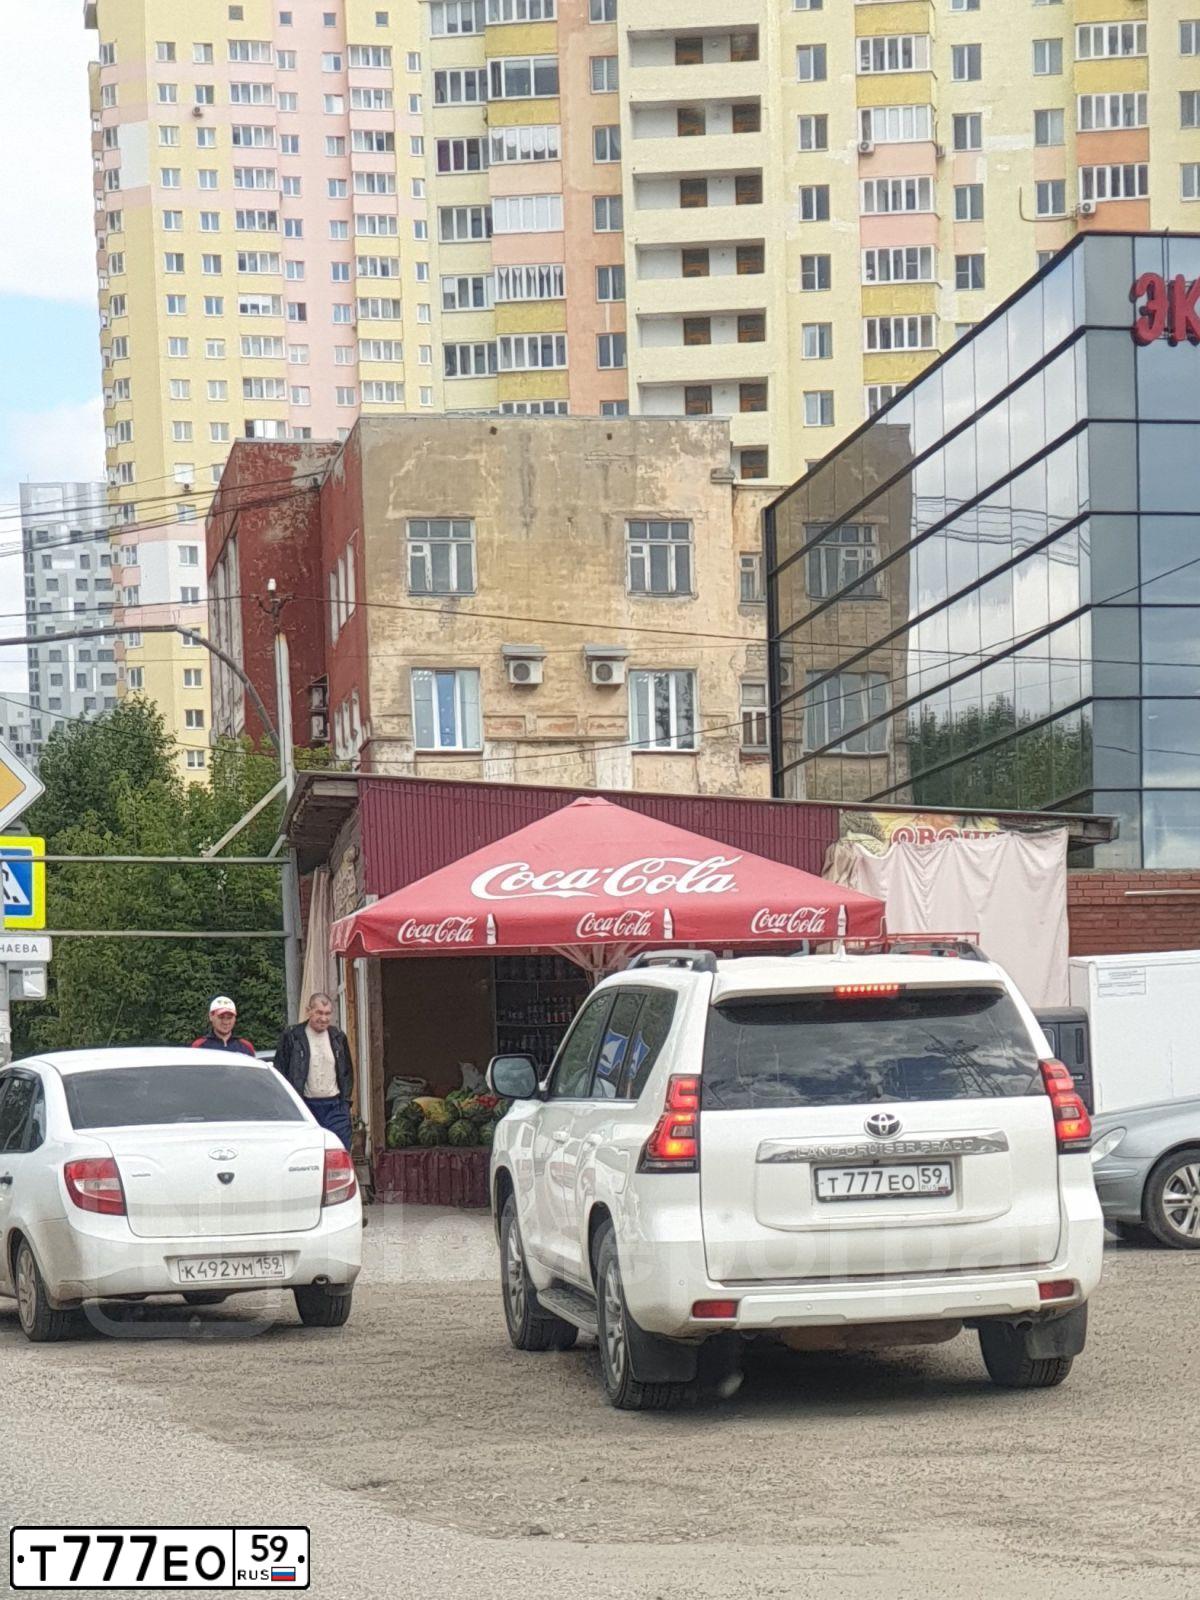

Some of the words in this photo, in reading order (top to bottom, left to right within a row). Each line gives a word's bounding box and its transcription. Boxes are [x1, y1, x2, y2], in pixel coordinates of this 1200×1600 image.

[470, 855, 742, 899] Coca-Cola
[398, 916, 477, 944] Coca-Cola
[576, 909, 657, 938] Coca-Cola
[751, 906, 830, 935] Coca-Cola
[921, 1167, 942, 1184] 59
[256, 1257, 281, 1271] 159
